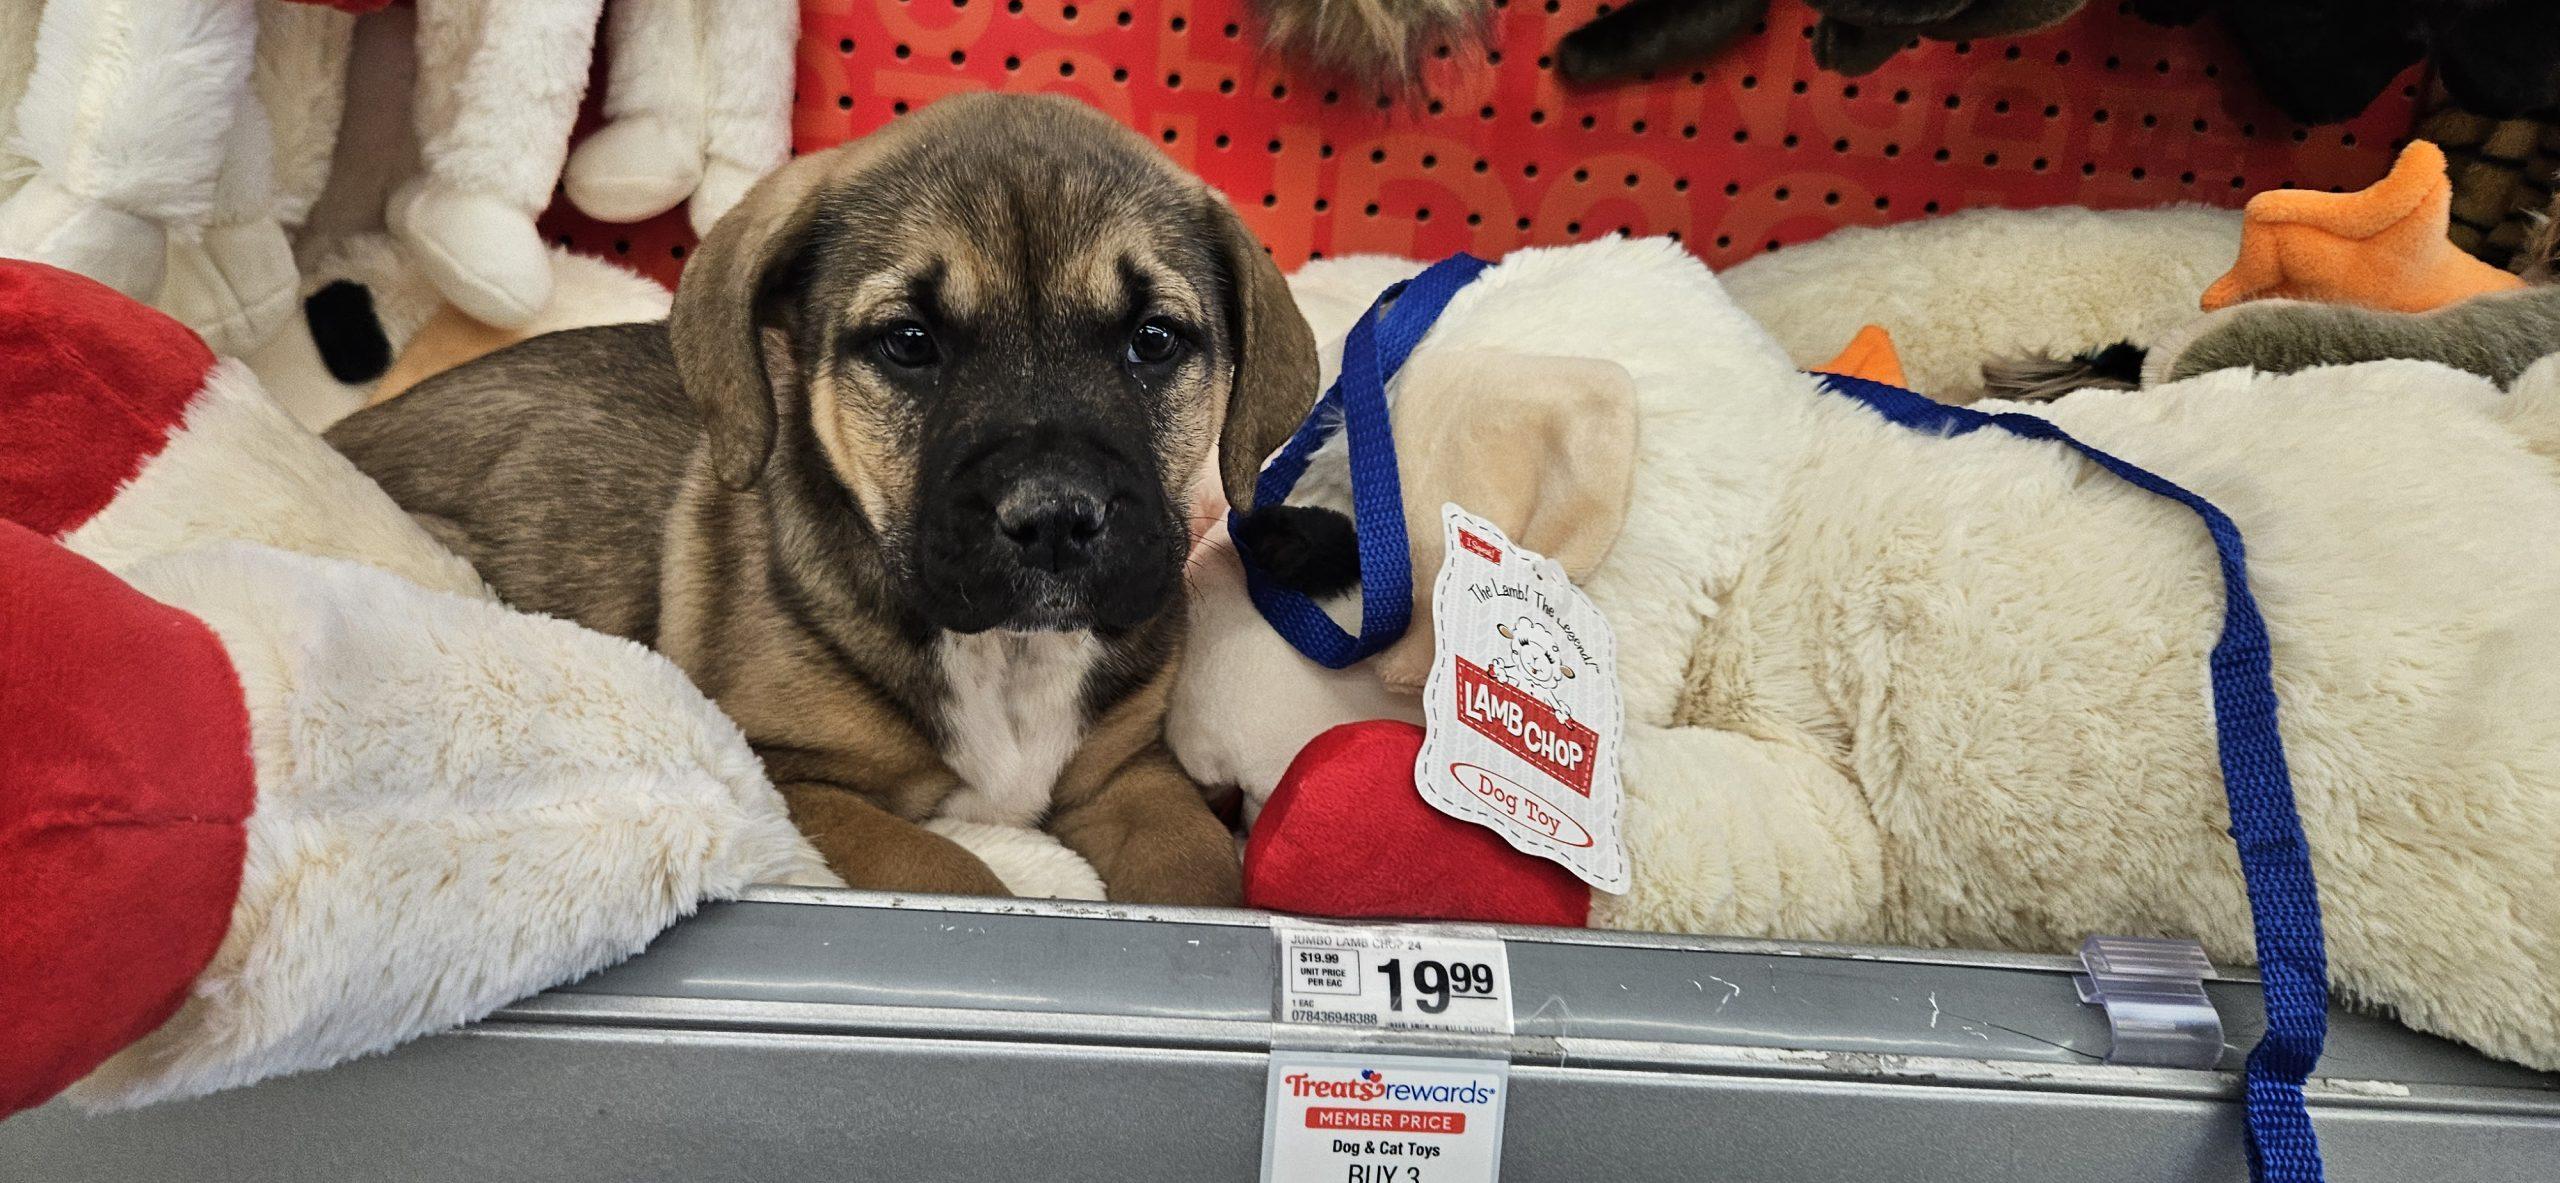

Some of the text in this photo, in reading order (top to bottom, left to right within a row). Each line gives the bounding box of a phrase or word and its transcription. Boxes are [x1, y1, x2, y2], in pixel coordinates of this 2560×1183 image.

[1468, 583, 1493, 603] The
[1491, 578, 1529, 602] Lamb!
[1533, 590, 1555, 618] The
[1464, 680, 1584, 771] LAMB CHOP
[1478, 773, 1562, 836] Dog Toy
[1291, 934, 1332, 946] JUMBO
[1336, 938, 1368, 948] LAMB
[1408, 941, 1422, 951] 24
[1300, 952, 1339, 964] $19.99
[1300, 968, 1346, 977] UNIT PRICE
[1308, 978, 1343, 987] PER EAC
[1292, 1010, 1378, 1025] 078436948388
[1285, 1072, 1386, 1101] Treats
[1319, 1111, 1452, 1130] MEMBER PRICE
[1333, 1139, 1440, 1159] Dog & Cat Toys
[1348, 1164, 1398, 1183] BUY
